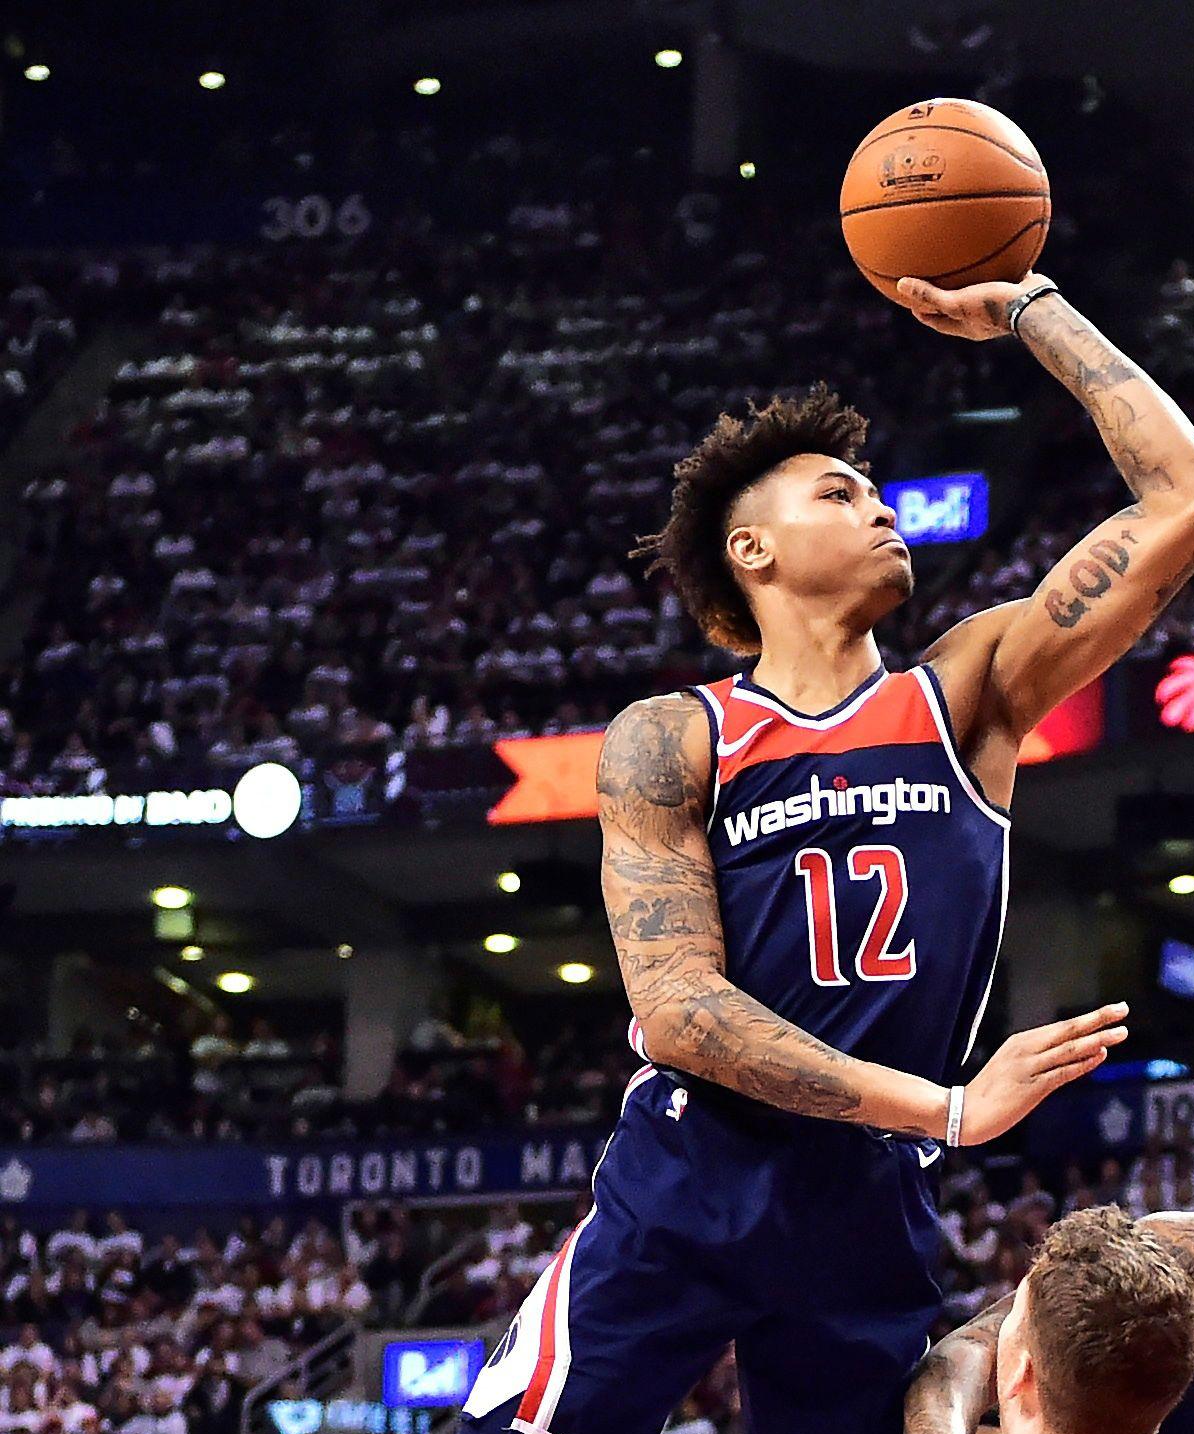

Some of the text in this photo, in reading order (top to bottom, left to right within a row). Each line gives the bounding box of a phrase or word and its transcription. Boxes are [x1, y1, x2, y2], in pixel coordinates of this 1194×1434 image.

[260, 194, 371, 240] 306
[724, 774, 951, 846] washington
[795, 844, 917, 987] 12
[266, 1140, 606, 1198] TORONTO MA
